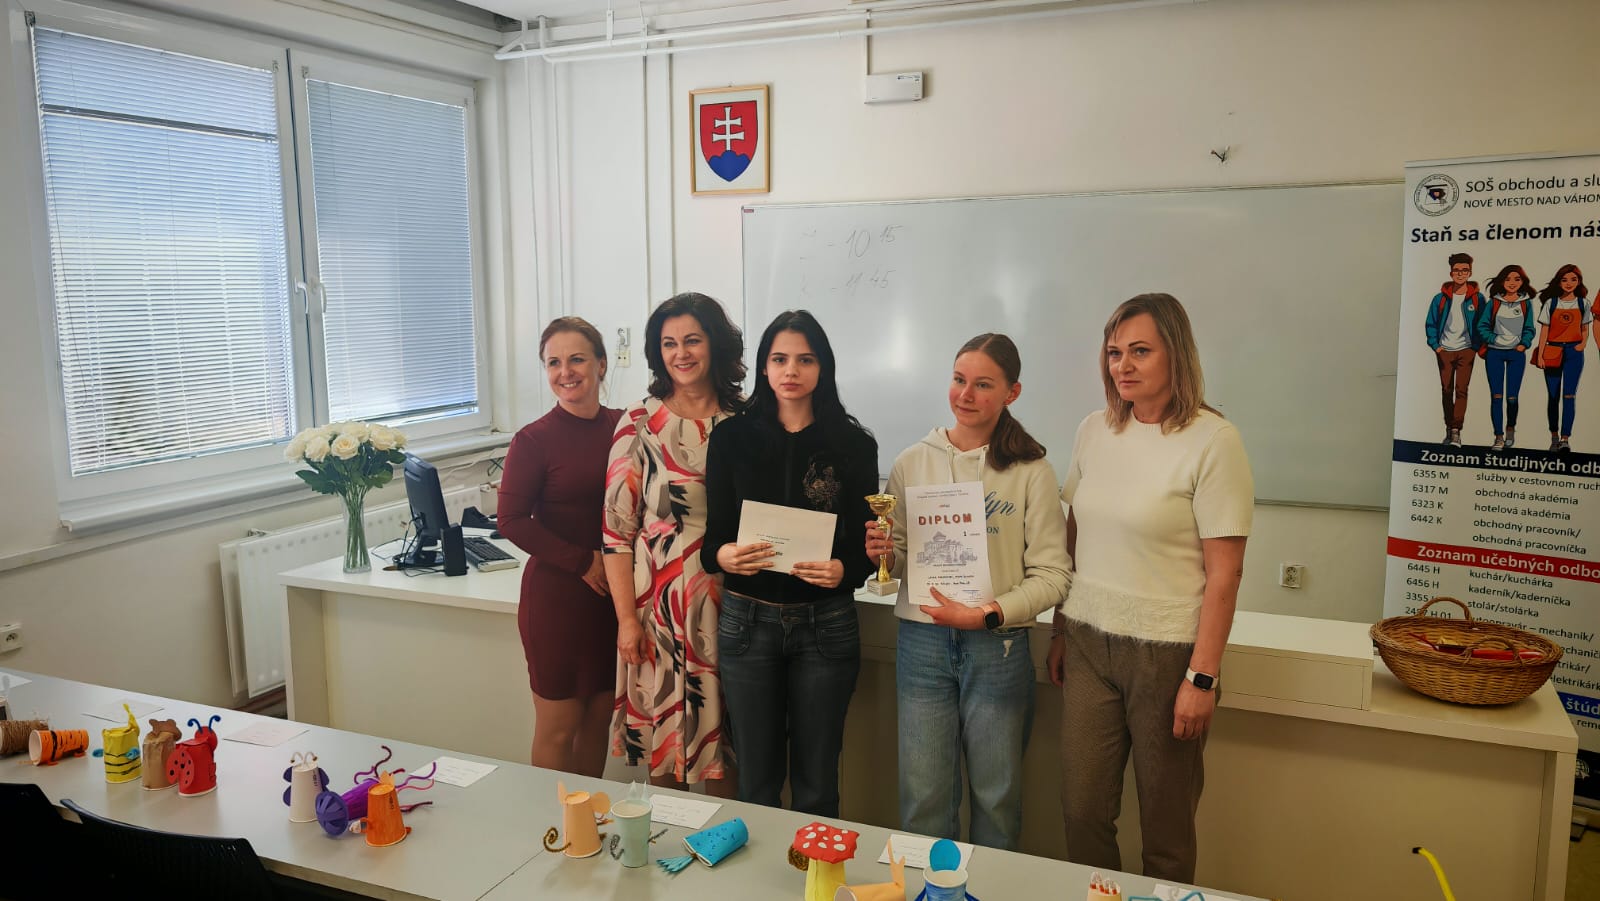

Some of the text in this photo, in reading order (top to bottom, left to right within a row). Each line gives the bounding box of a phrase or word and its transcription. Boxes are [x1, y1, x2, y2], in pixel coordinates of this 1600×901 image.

[1466, 177, 1494, 192] SOŠ
[1499, 176, 1565, 191] obchodu
[1570, 178, 1578, 187] a
[1464, 198, 1492, 208] NOVÉ
[1496, 196, 1533, 207] MESTO
[1537, 195, 1560, 205] NAD
[1411, 226, 1452, 243] Staň
[1458, 229, 1479, 241] sa
[1486, 224, 1562, 240] členom
[1421, 450, 1480, 465] Zoznam
[1485, 453, 1566, 472] študijných
[1413, 469, 1449, 479] 6355 M
[1476, 473, 1507, 484] služby
[1519, 476, 1575, 488] cestovnom
[1412, 484, 1448, 495] 6317 M
[1475, 488, 1579, 505] obchodná akadémia
[1412, 499, 1435, 509] 6323
[1474, 503, 1571, 520] hotelová akadémia
[918, 513, 972, 525] DIPLOM
[1410, 514, 1434, 524] 6442
[1473, 519, 1581, 538] obchodný pracovník/
[1472, 534, 1586, 555] obchodná pracovníčka
[1407, 563, 1440, 574] 6445 H
[1417, 545, 1600, 579] Zoznam učebných odbo
[1406, 578, 1439, 589] 6456 H
[1469, 569, 1553, 588] kuchár/kuchárka
[1406, 592, 1428, 602] 3355
[1405, 607, 1428, 617] 247
